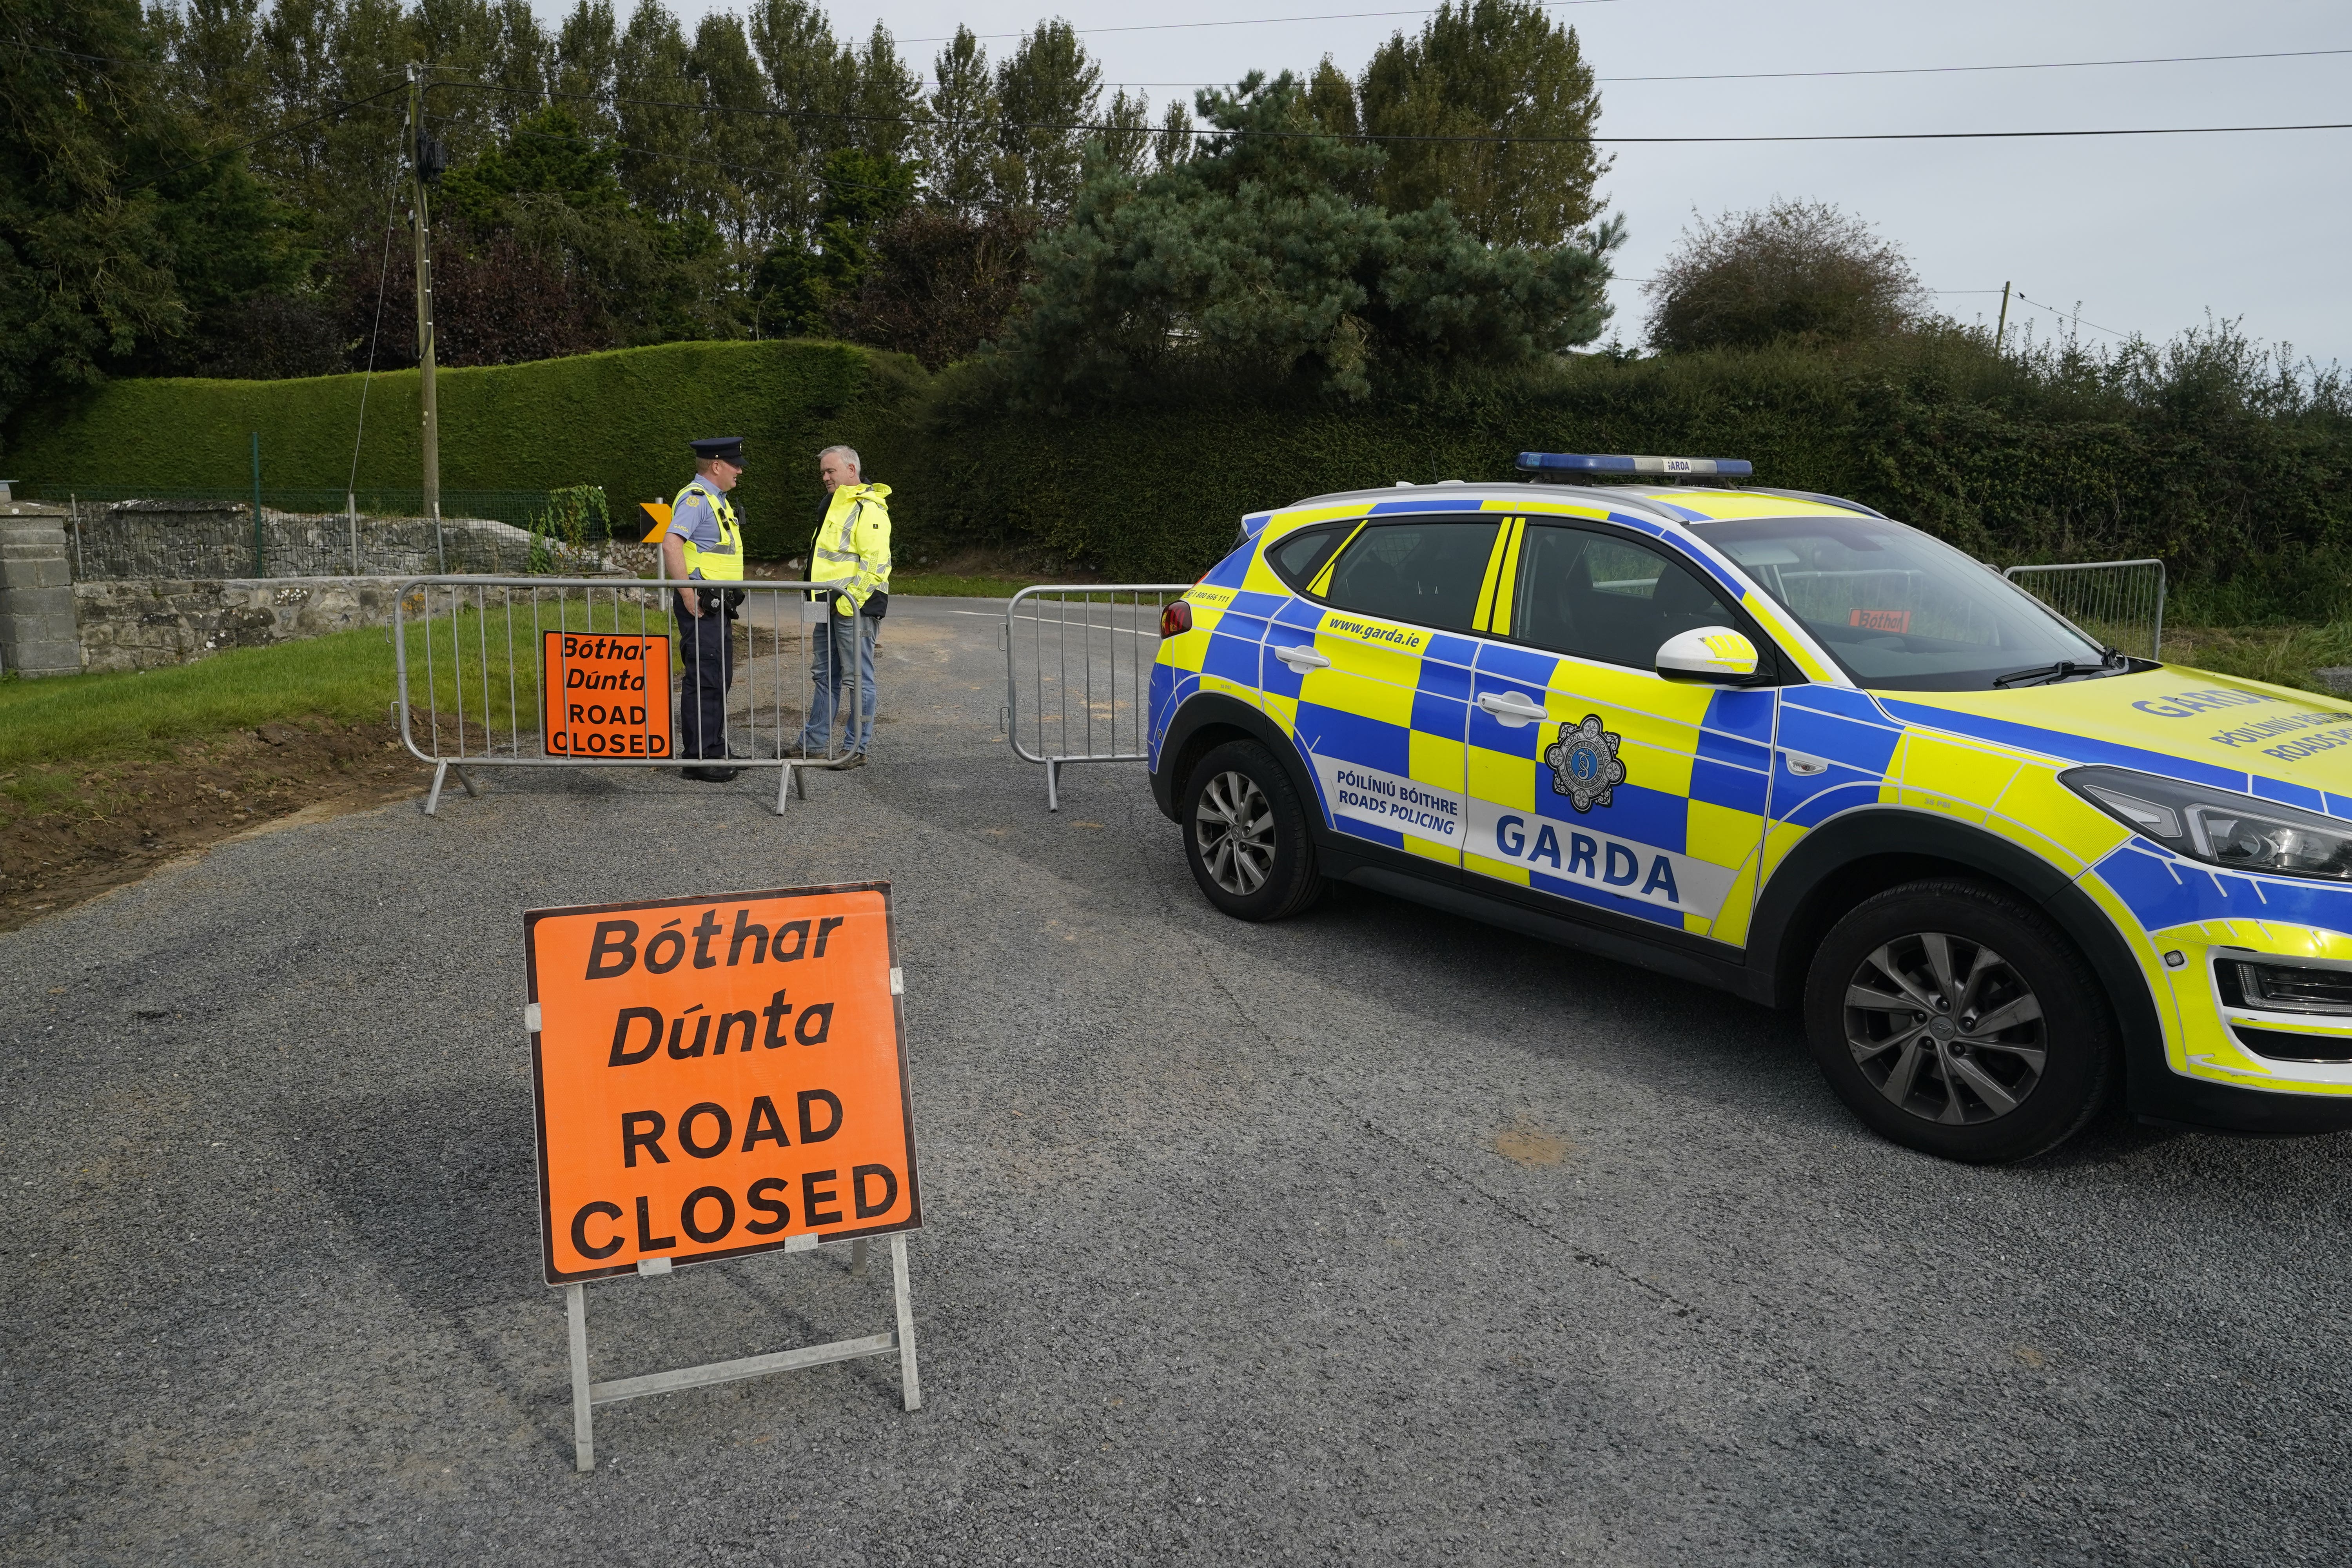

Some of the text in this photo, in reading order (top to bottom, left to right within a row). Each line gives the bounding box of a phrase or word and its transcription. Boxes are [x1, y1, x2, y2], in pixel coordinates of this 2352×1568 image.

[673, 524, 689, 533] GARDA
[1329, 618, 1419, 648] www.garda.ie
[561, 637, 652, 661] Bóthar
[566, 669, 645, 691] Dúnta
[570, 704, 647, 725] ROAD
[2132, 689, 2290, 718] GARDA
[553, 731, 665, 753] CLOSED
[2209, 717, 2308, 748] PÓILÍNIÚ
[2261, 734, 2347, 762] ROADS
[1337, 770, 1457, 816] PÓILÍNIÚ BÓITHRE
[1937, 800, 1951, 809] PSI
[1339, 790, 1455, 835] ROADS POLICING
[1496, 815, 1679, 903] GARDA
[585, 909, 844, 980] Bóthar
[608, 988, 834, 1067] Dúnta
[622, 1089, 843, 1168] ROAD
[571, 1163, 898, 1260] CLOSED
